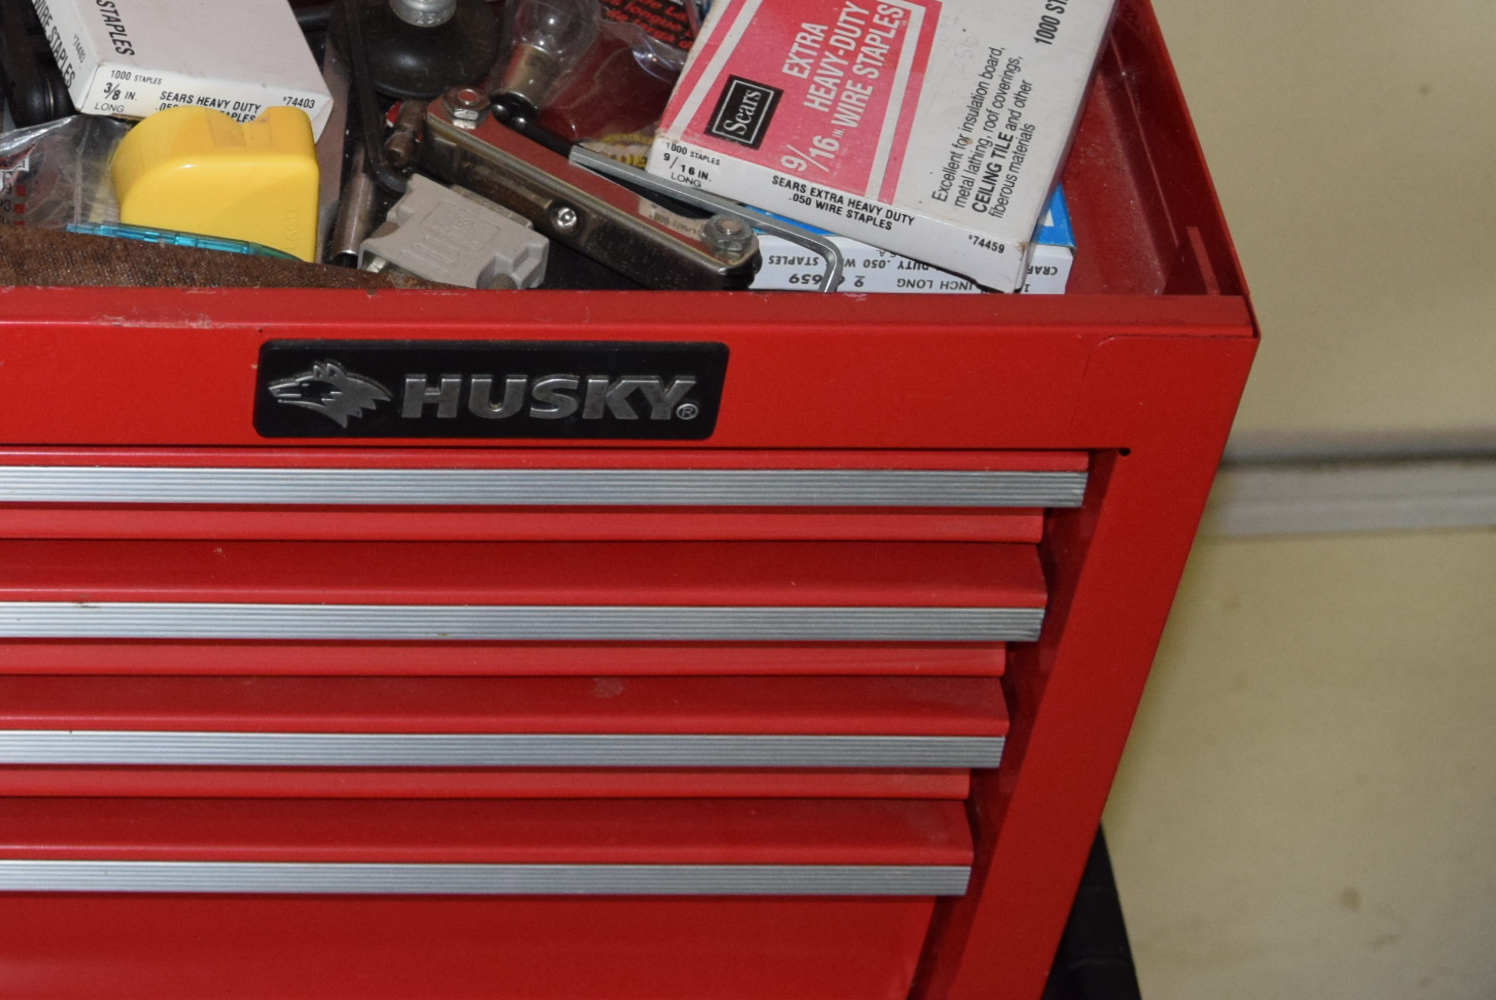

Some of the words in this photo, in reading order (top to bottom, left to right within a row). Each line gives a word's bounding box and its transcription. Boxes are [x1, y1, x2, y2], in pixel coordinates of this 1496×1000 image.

[96, 0, 135, 57] STAPLES
[1033, 9, 1061, 48] 1000
[48, 25, 76, 90] STAPLES
[781, 20, 829, 81] EXTRA
[802, 0, 872, 113] HEAVY-DUTY
[976, 43, 1006, 79] board,
[103, 81, 121, 101] 3/8
[124, 90, 138, 101] IN.
[110, 69, 132, 81] 1000
[134, 74, 163, 86] STAPLES
[779, 132, 842, 175] 9/16
[830, 74, 868, 130] WIRE
[853, 3, 906, 81] STAPLES
[986, 53, 1024, 109] coverings,
[1008, 77, 1035, 108] other
[94, 102, 125, 113] LONG
[159, 90, 195, 105] SEARS
[196, 95, 231, 109] HEAVY
[232, 101, 262, 113] DUTY
[723, 86, 763, 137] Sears
[955, 77, 992, 133] insulation
[977, 107, 1002, 133] roof
[1000, 107, 1023, 132] and
[665, 142, 688, 155] 1000
[689, 150, 721, 166] STAPLES
[950, 133, 969, 149] for
[961, 132, 994, 175] lathing,
[988, 130, 1014, 161] TILE
[1002, 122, 1038, 173] materials
[670, 172, 702, 188] LONG
[929, 149, 965, 202] Excellent
[949, 174, 976, 207] metal
[968, 160, 1005, 213] CEILING
[771, 174, 807, 194] SEARS
[809, 185, 845, 207] EXTRA
[847, 196, 883, 217] HEAVY
[885, 207, 916, 227] DUTY
[788, 193, 812, 208] .050
[815, 200, 843, 217] WIRE
[845, 208, 894, 232] STAPLES
[987, 172, 1019, 218] fiberous
[767, 253, 820, 267] STAPLES
[861, 257, 891, 270] .050
[1025, 263, 1058, 277] CRAF
[895, 276, 934, 290] LONG
[938, 279, 973, 292] INCH
[403, 373, 697, 420] HUSKY
